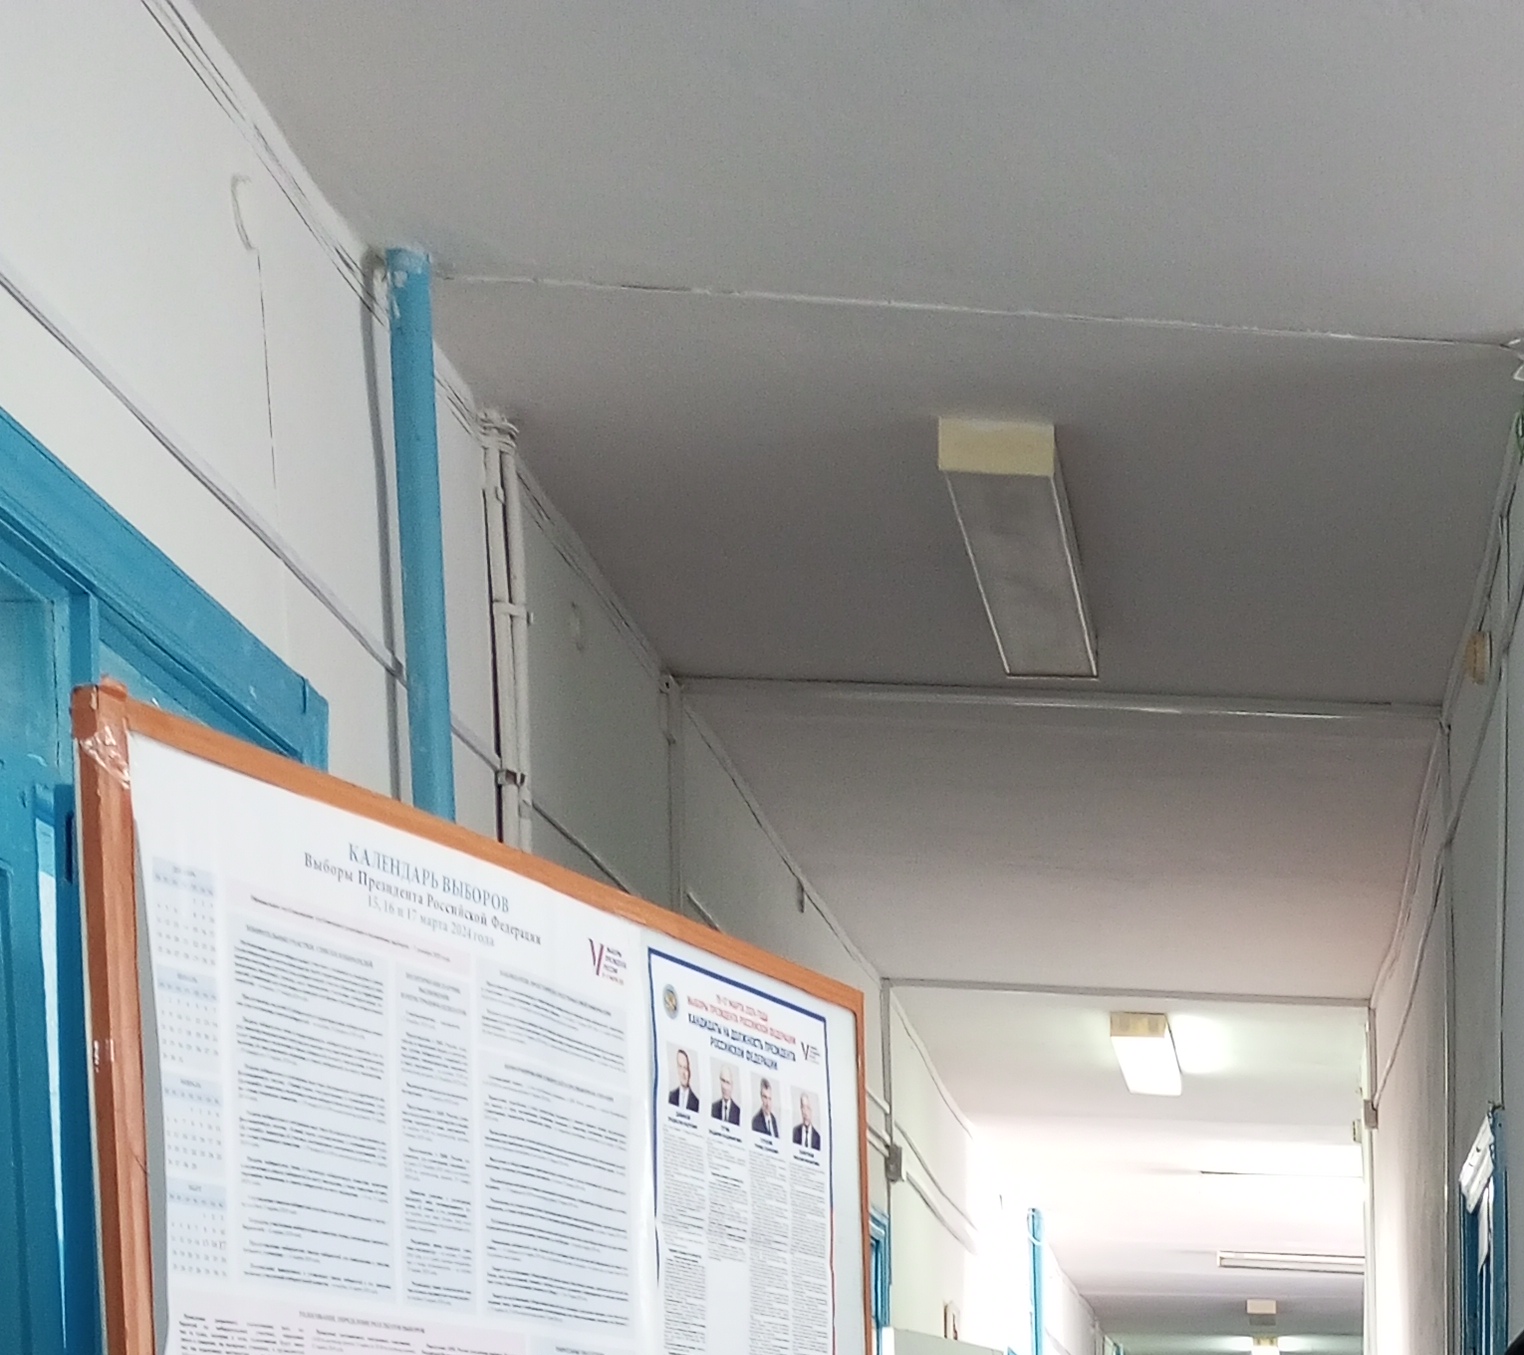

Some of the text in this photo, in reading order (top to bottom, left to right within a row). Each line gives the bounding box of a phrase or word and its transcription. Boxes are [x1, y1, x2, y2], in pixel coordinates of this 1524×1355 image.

[304, 852, 354, 883] Выборы
[358, 870, 424, 905] Президента
[427, 893, 488, 926] Российской
[349, 843, 510, 914] КАЛЕНДАРЬ ВЫБОРОВ
